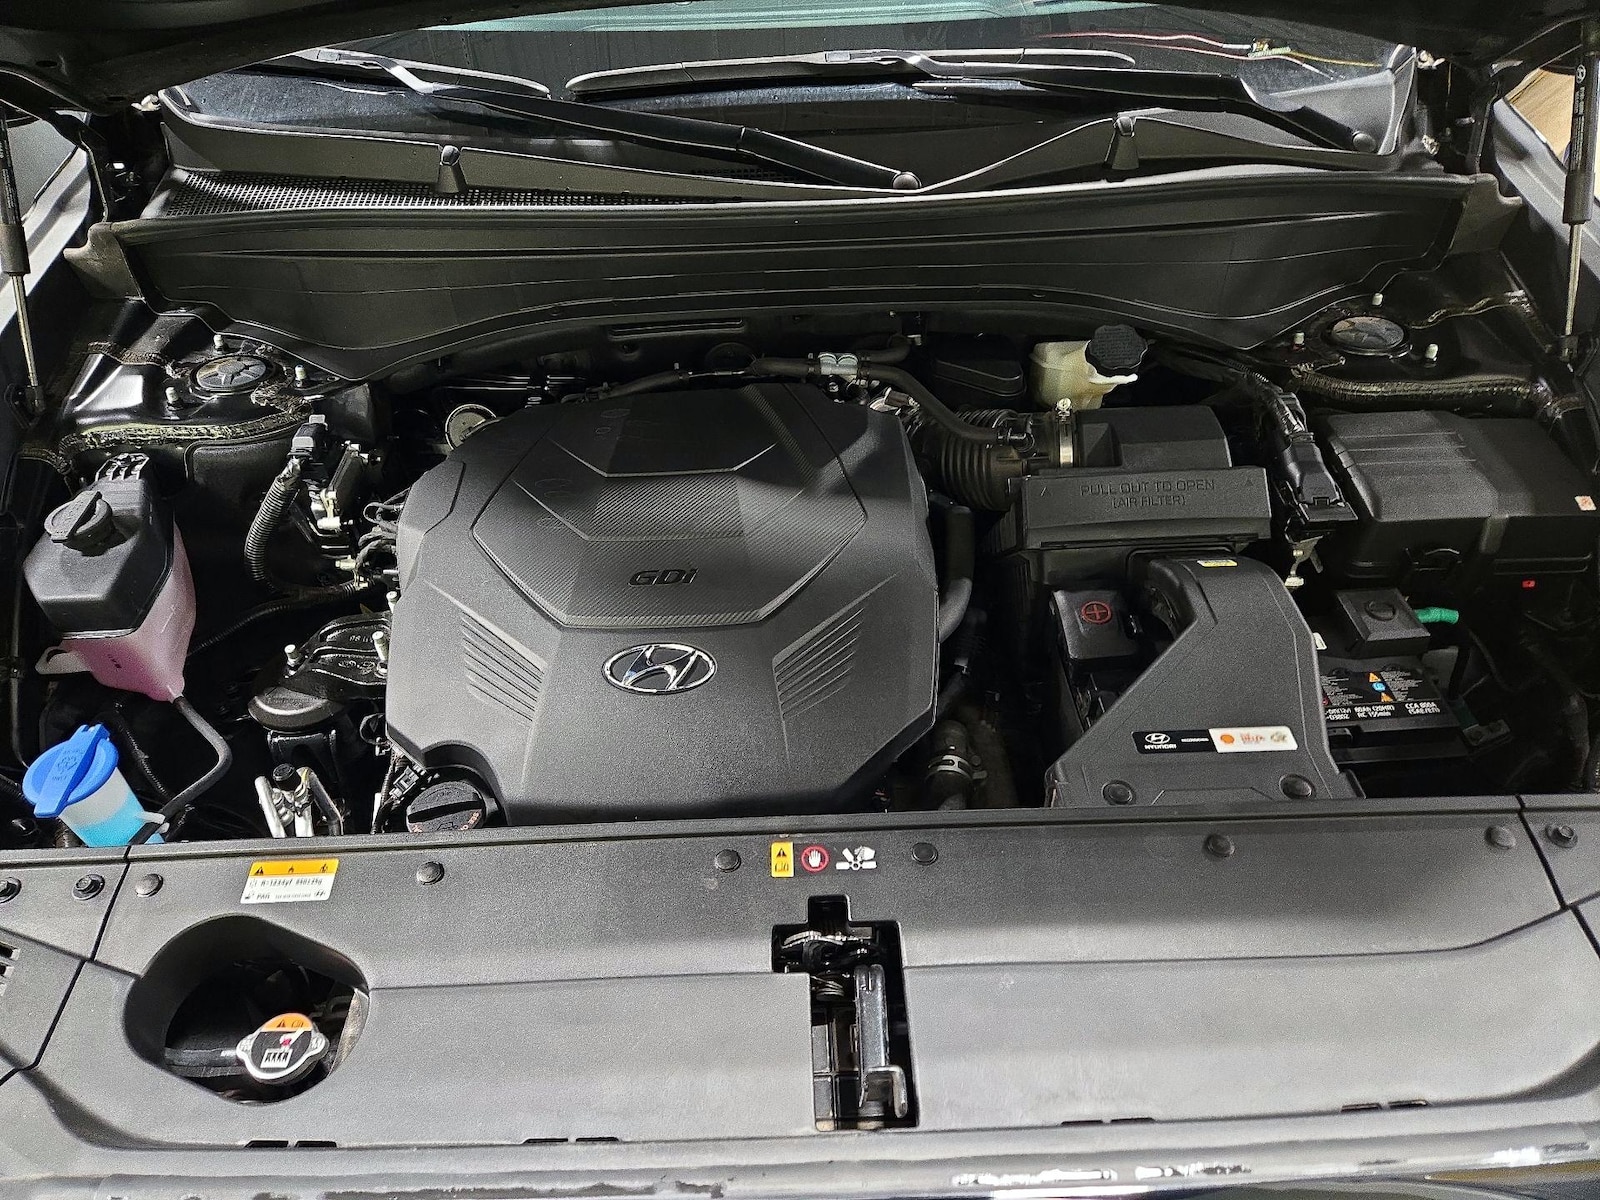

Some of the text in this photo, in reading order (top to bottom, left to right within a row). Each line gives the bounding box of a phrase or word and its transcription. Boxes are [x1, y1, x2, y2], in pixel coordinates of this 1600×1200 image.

[1080, 480, 1215, 496] PULL OUT TO OPEN
[1112, 496, 1186, 508] (AIR FILTER)
[627, 568, 698, 586] GDi
